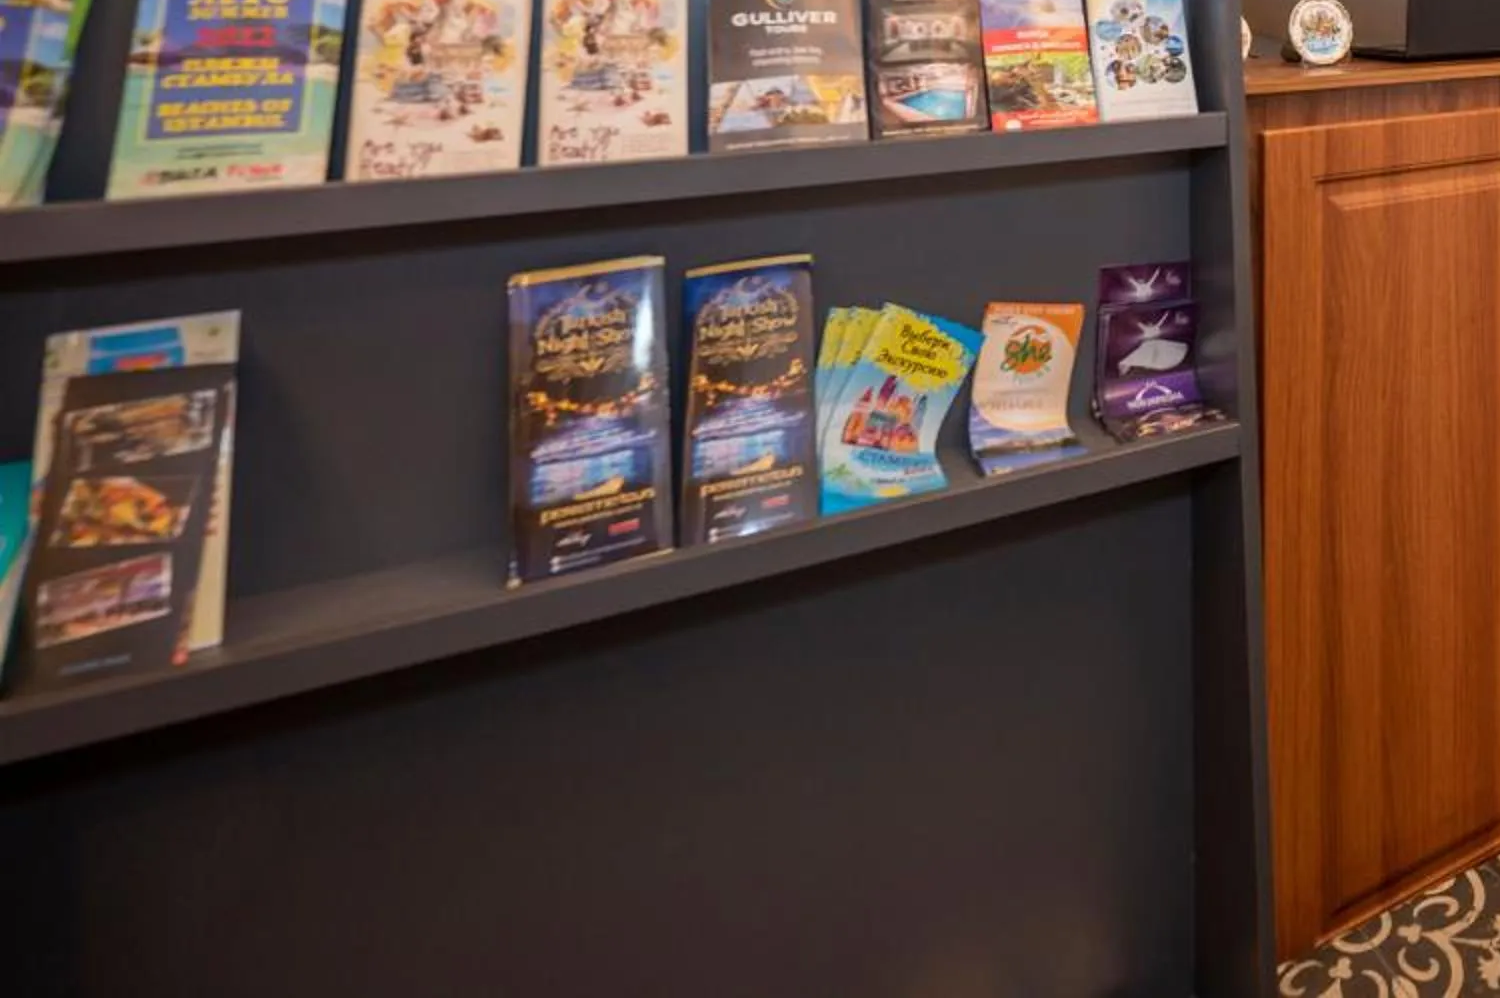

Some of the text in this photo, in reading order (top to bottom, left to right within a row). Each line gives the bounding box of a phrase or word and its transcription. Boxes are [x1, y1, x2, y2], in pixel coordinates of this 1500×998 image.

[731, 10, 838, 27] GULLIVER
[901, 324, 952, 351] Выбери
[901, 341, 937, 359] Свою
